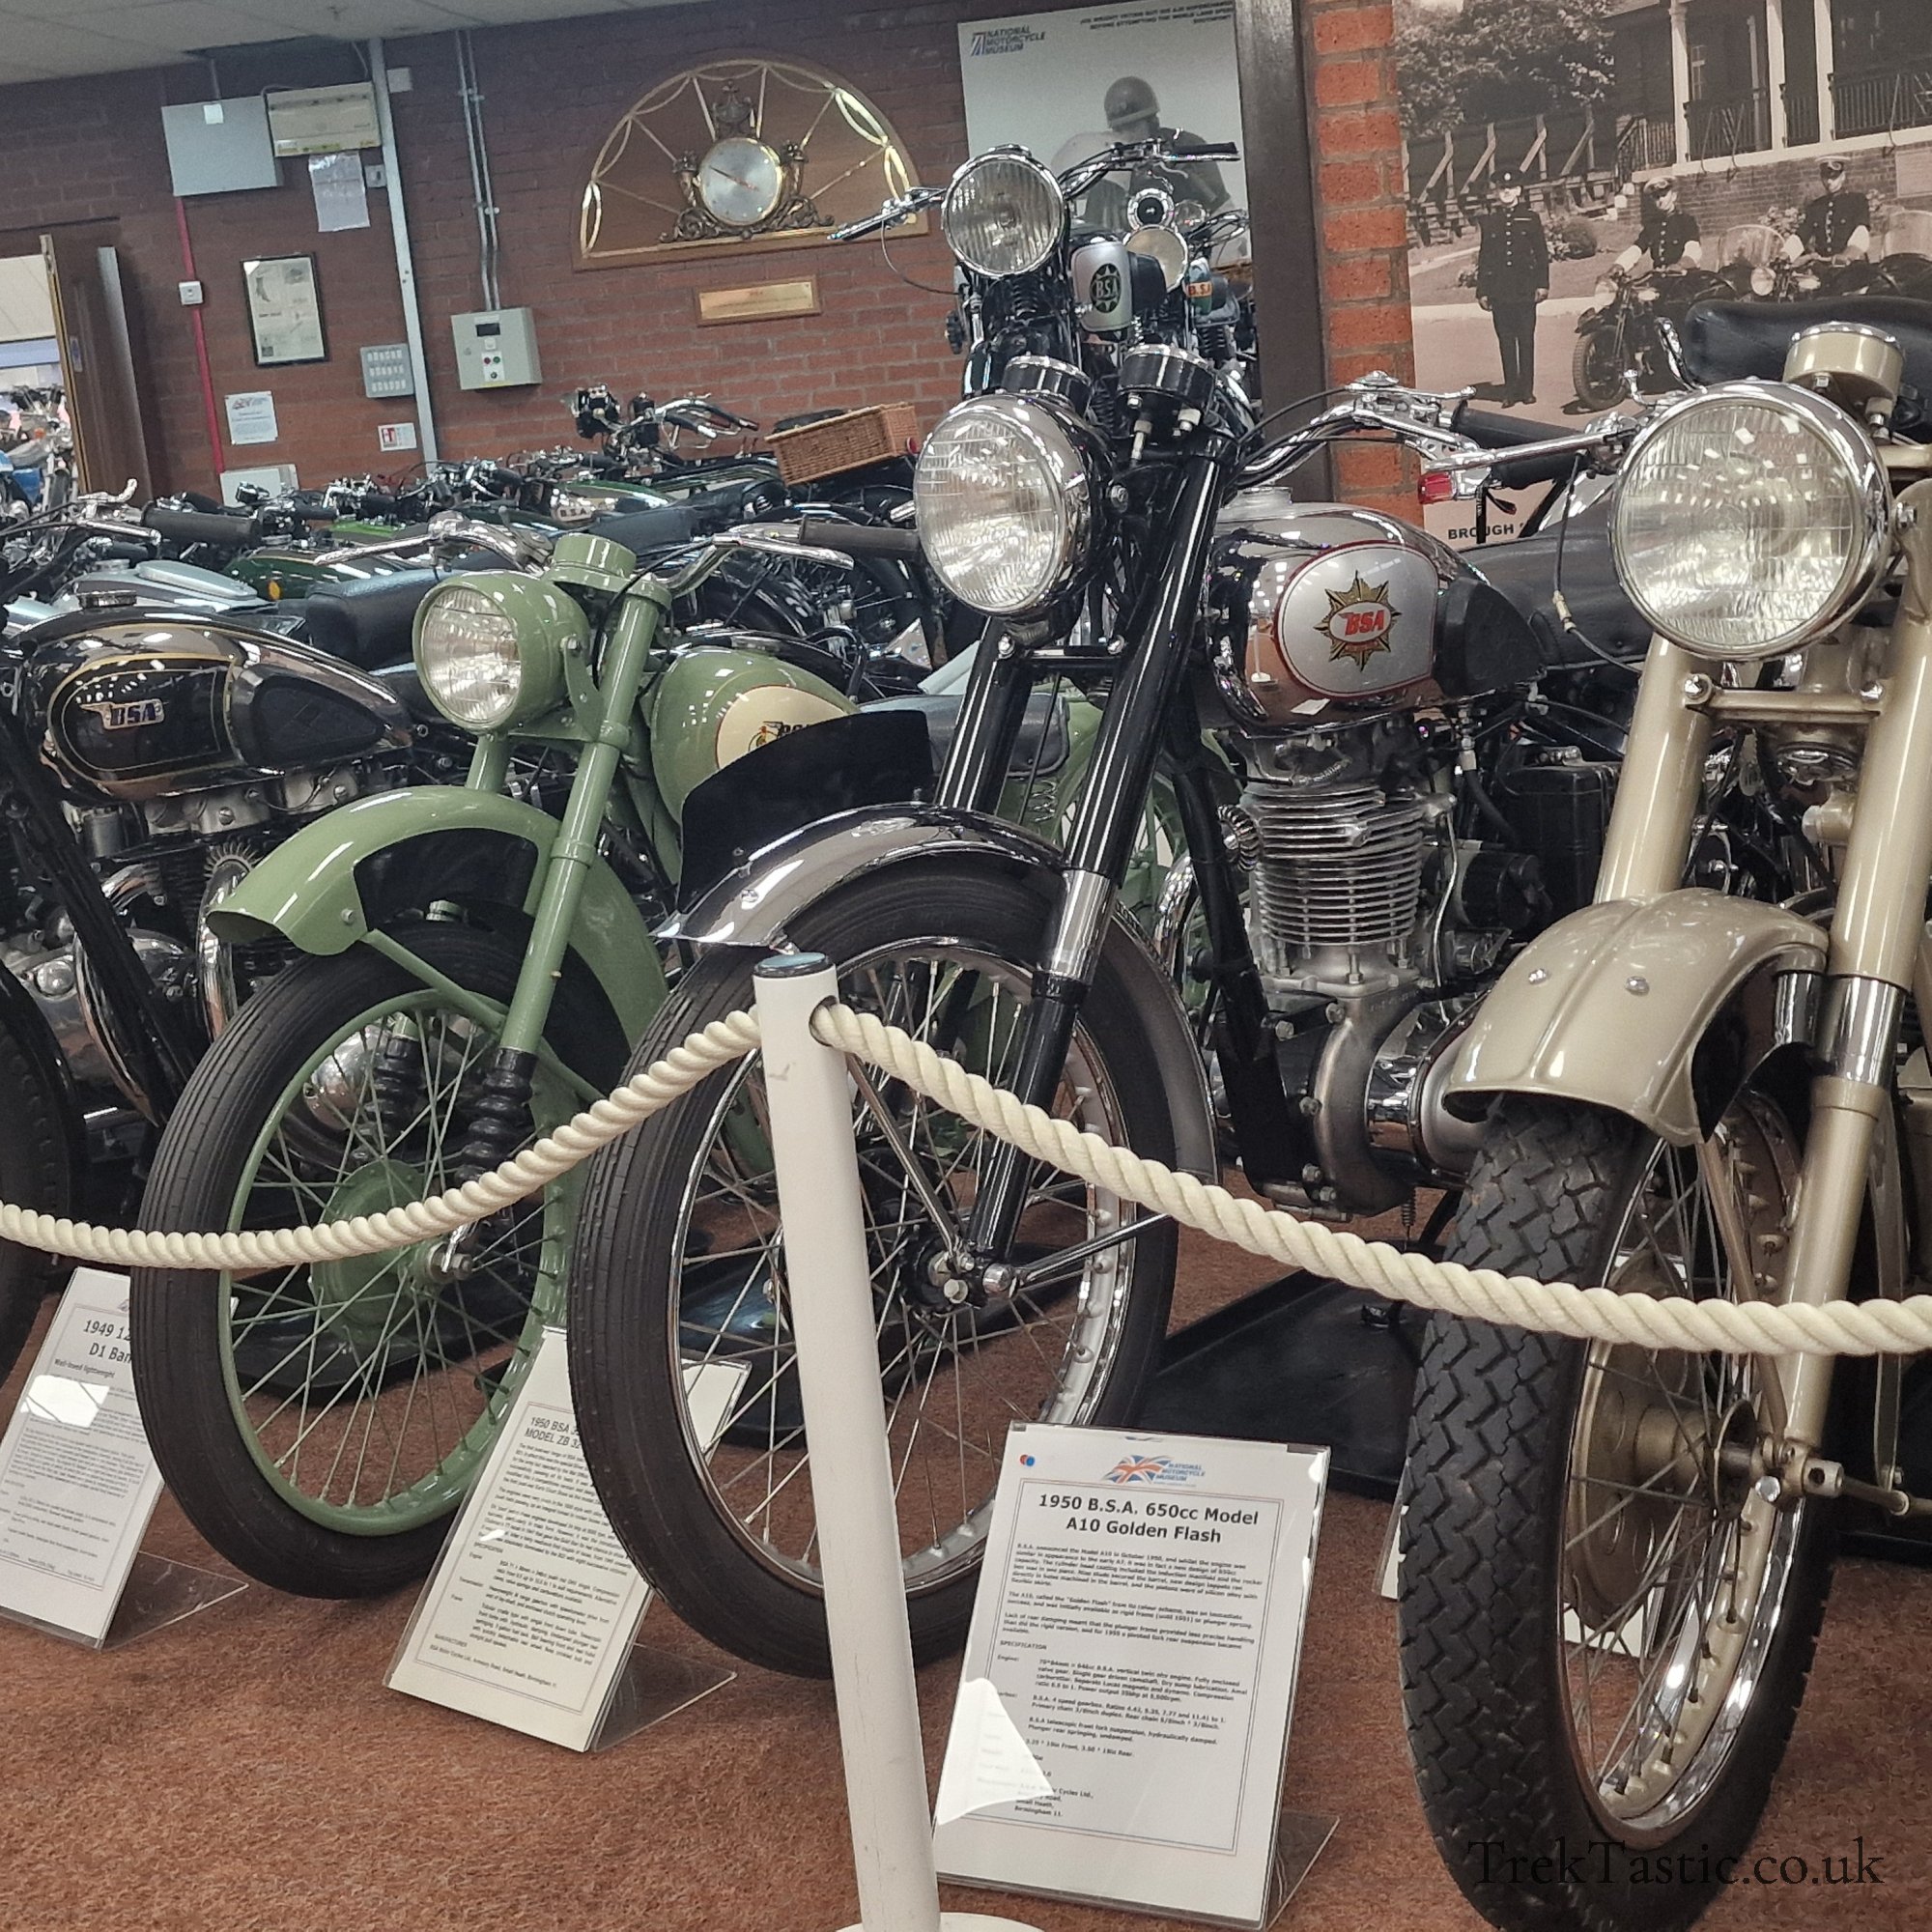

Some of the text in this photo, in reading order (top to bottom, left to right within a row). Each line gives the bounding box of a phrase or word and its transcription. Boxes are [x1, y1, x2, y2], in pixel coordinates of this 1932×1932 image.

[985, 31, 1045, 46] MOTORCYCLE
[987, 25, 1030, 37] NATIONAL
[985, 43, 1024, 55] MUSEUM
[560, 508, 587, 518] BSA
[1340, 610, 1385, 636] BSA
[108, 702, 156, 726] BSA
[83, 1320, 114, 1337] 1949
[89, 1342, 106, 1358] D1
[531, 1416, 551, 1429] 1950
[551, 1420, 570, 1434] BSA
[525, 1428, 554, 1443] MODEL
[556, 1435, 571, 1446] ZB
[1038, 1493, 1259, 1524] 1950 B.S.A. 650cc Model
[1066, 1517, 1221, 1544] A10 Golden Flash
